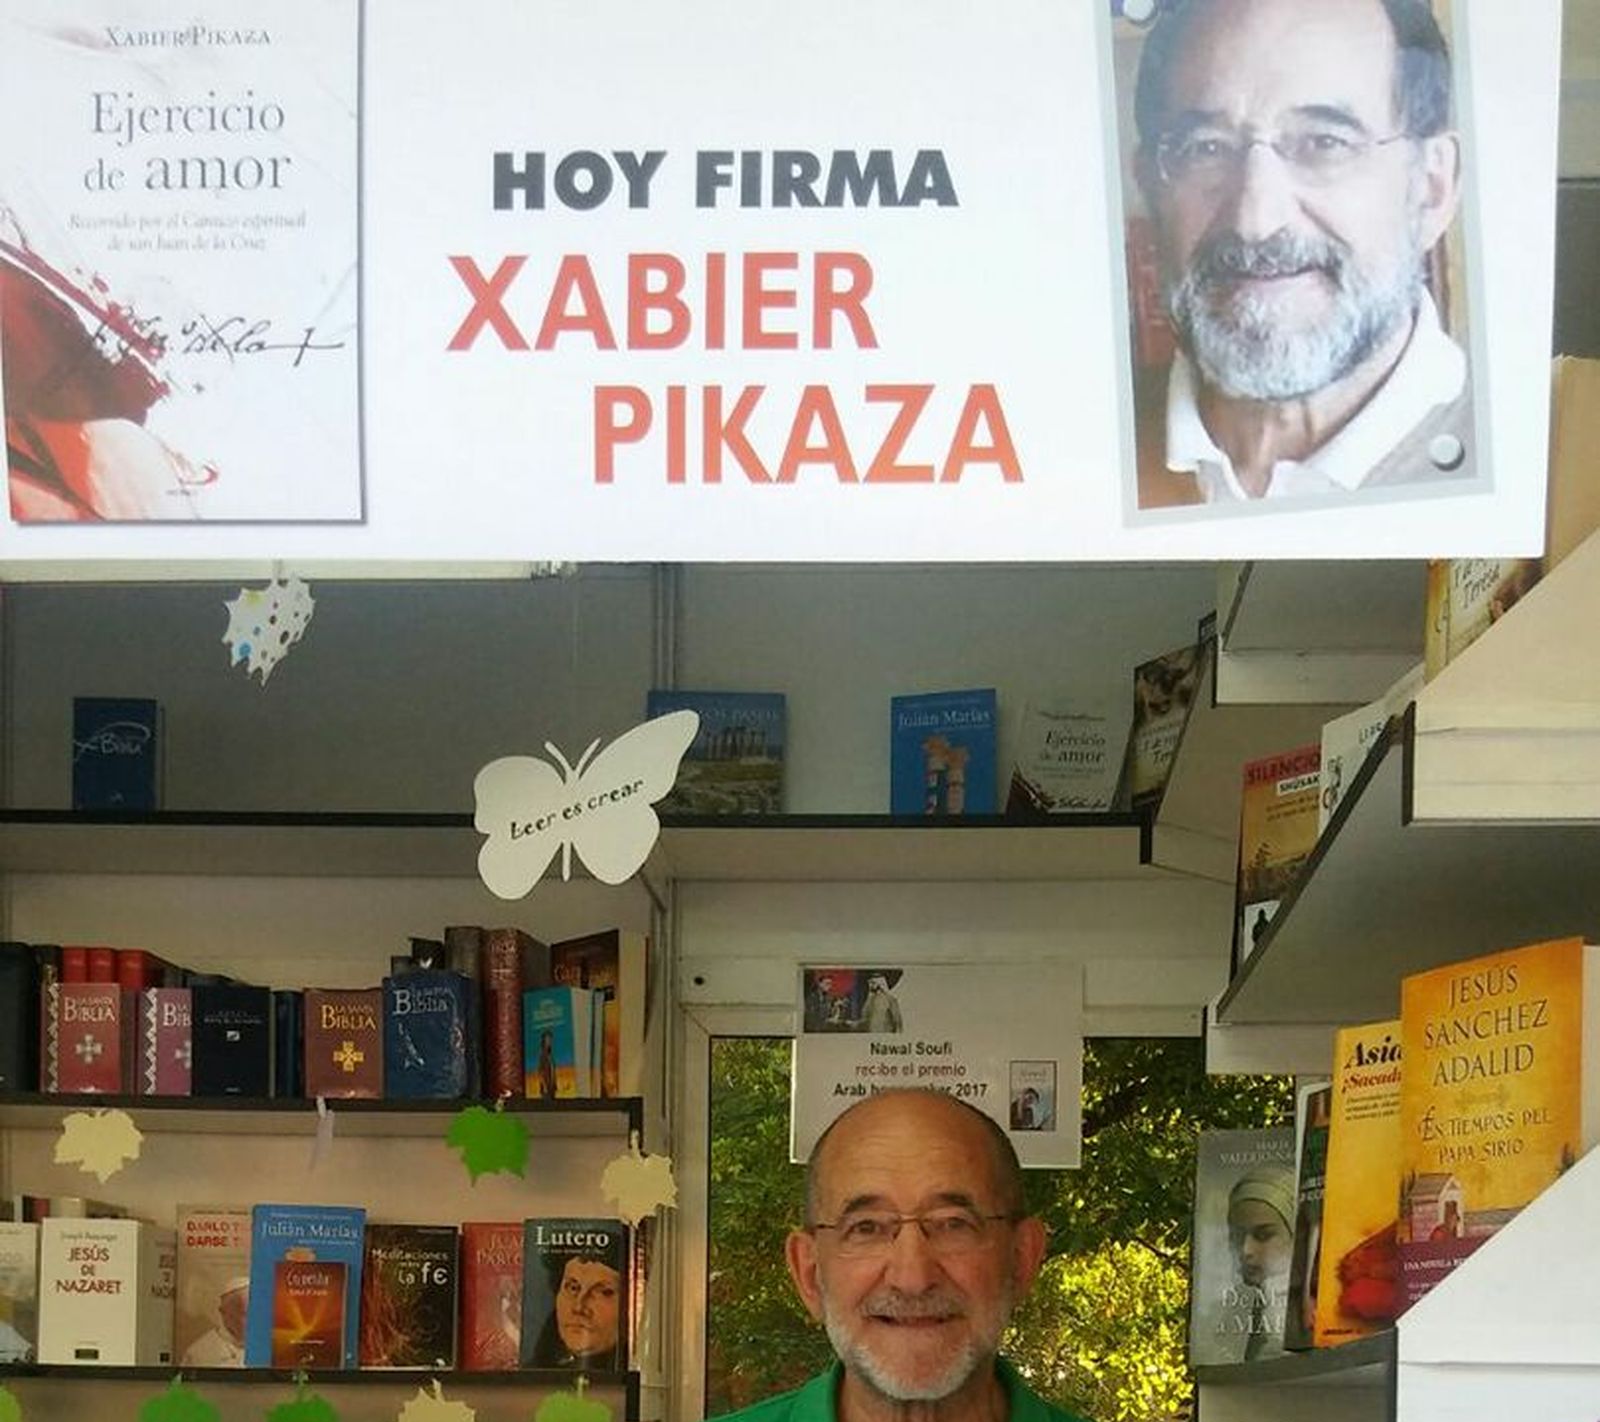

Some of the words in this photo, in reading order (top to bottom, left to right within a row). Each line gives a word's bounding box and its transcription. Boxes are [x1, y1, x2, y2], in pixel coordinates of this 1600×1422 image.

[105, 26, 184, 46] XABIER
[193, 25, 271, 46] PIKAZA
[91, 91, 285, 148] Ejercicio
[84, 157, 125, 191] de
[145, 155, 292, 191] amor
[493, 150, 667, 210] HOY
[694, 150, 960, 208] FIRMA
[445, 252, 880, 352] XABIER
[593, 383, 1025, 484] PIKAZA
[1044, 730, 1106, 749] Ejercicio
[1056, 749, 1105, 765] amor
[509, 811, 556, 841] Leer
[562, 800, 583, 821] es
[587, 777, 645, 812] crear
[321, 1004, 377, 1031] BIBLIA
[870, 1042, 912, 1055] Nawal
[916, 1042, 952, 1055] Soufi
[856, 1064, 897, 1077] recibe
[902, 1064, 914, 1076] el
[918, 1064, 967, 1080] premio
[1433, 1043, 1535, 1087] ADALID
[833, 1083, 866, 1097] Arab
[956, 1083, 989, 1098] 2017
[536, 1225, 610, 1248] Lutero
[421, 1261, 449, 1285] fe
[56, 1279, 122, 1296] NAZARET
